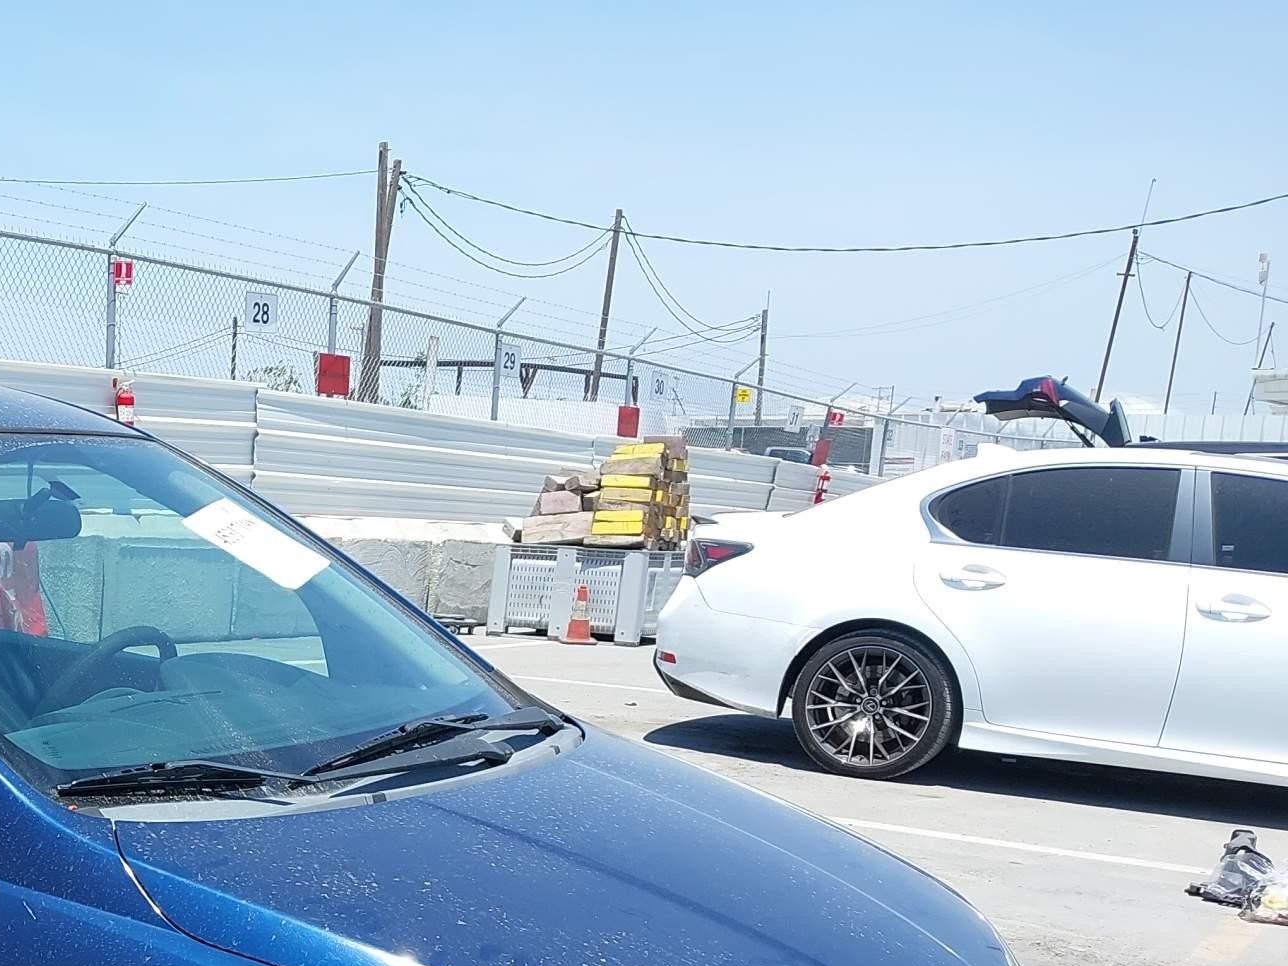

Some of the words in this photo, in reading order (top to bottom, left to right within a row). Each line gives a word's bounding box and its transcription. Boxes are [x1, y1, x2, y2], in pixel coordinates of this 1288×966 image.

[252, 301, 270, 325] 28
[502, 350, 516, 372] 29
[653, 377, 669, 397] 30
